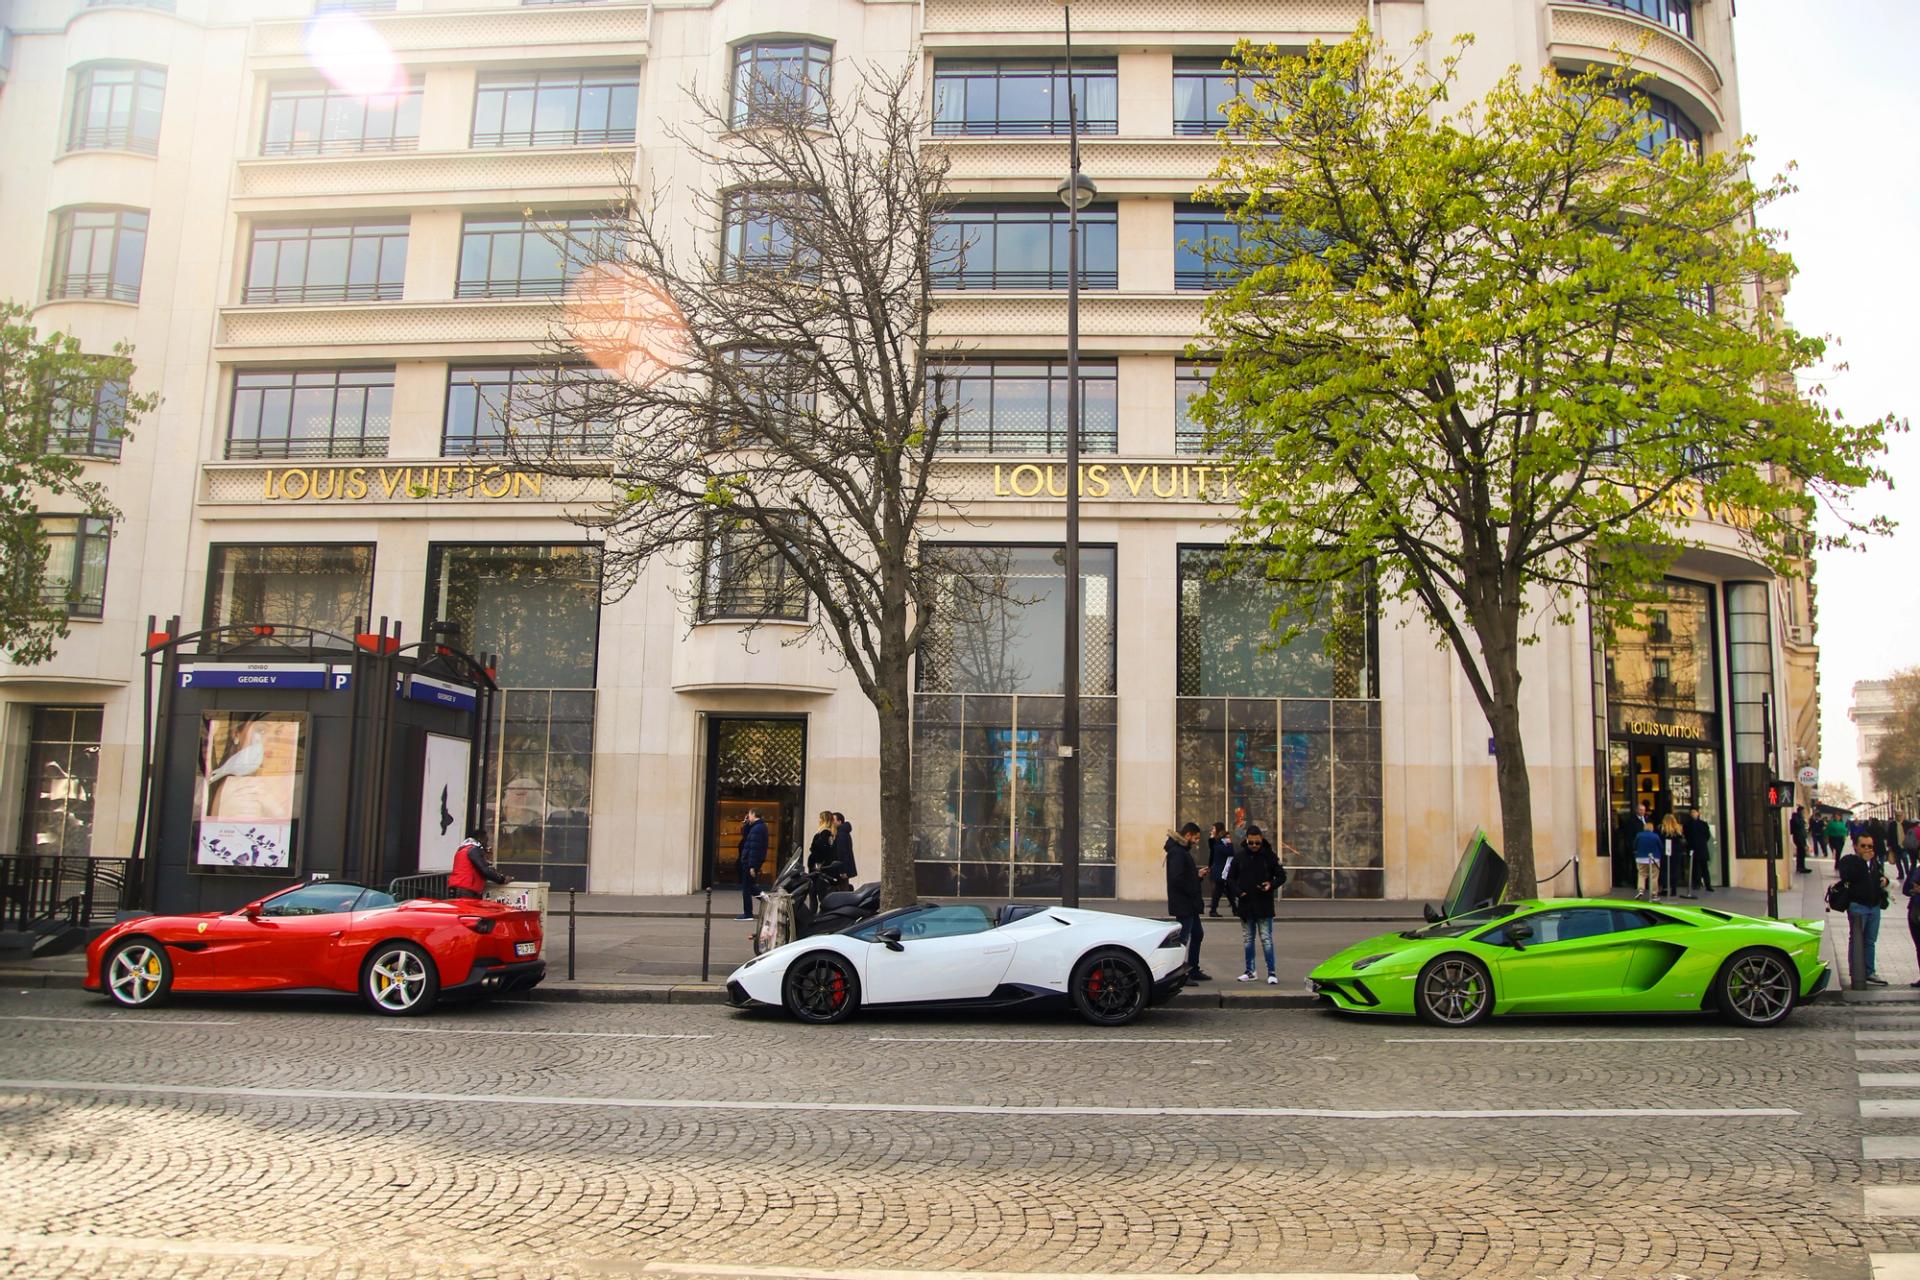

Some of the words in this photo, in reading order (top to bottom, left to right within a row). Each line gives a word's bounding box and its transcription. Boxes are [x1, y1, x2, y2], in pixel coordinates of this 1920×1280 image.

[264, 467, 368, 499] LOUIS
[379, 464, 543, 498] VUITTON
[994, 464, 1109, 497] LOUIS
[181, 673, 193, 688] P
[238, 676, 269, 684] GEORGE
[270, 676, 277, 684] V
[335, 675, 347, 690] P
[1631, 721, 1659, 737] LOUIS
[1659, 723, 1700, 740] VUITTON
